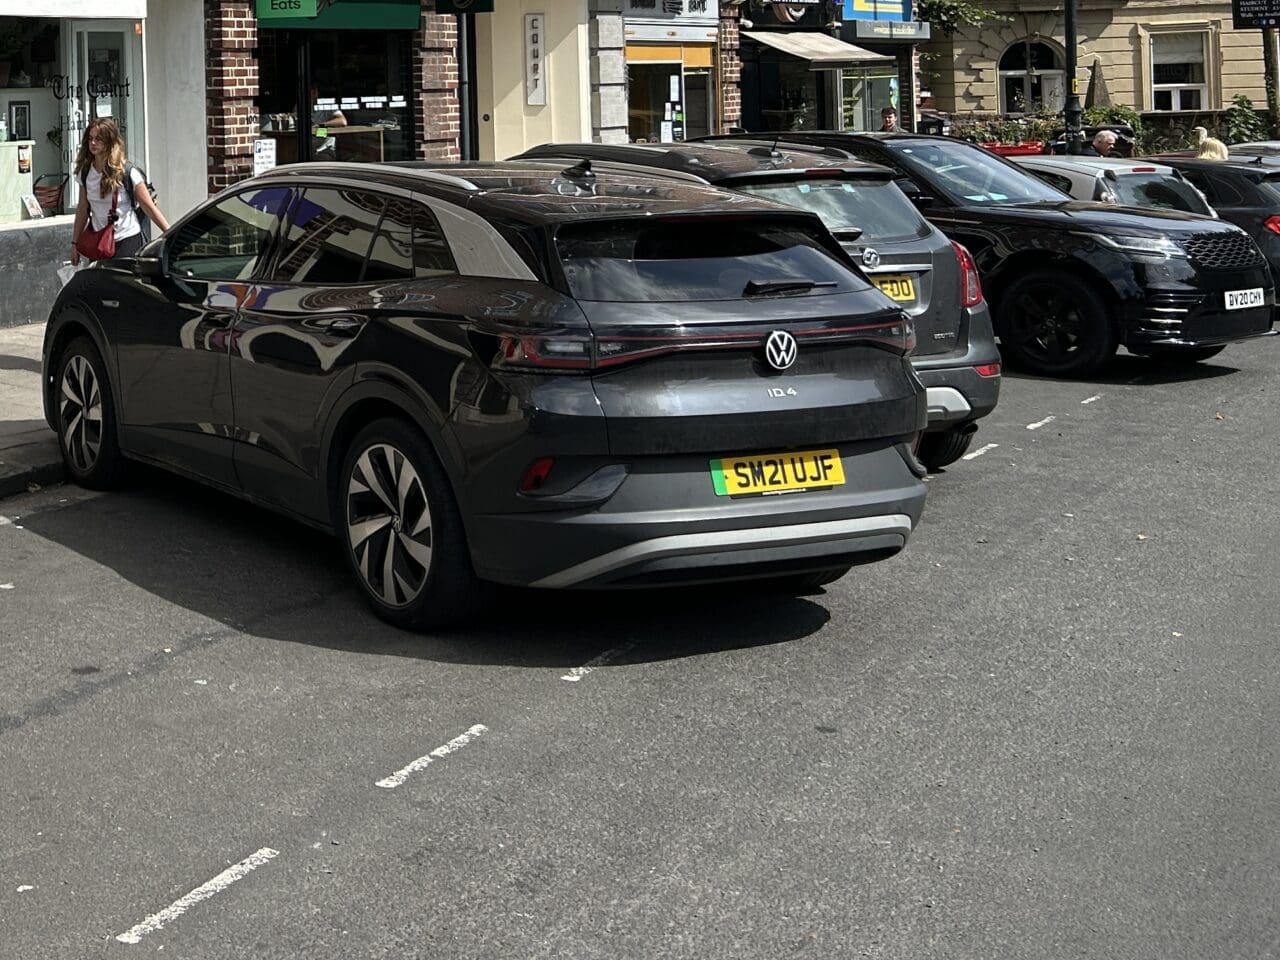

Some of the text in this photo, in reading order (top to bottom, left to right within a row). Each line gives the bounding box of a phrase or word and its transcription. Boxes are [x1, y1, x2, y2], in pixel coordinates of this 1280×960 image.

[531, 18, 540, 89] COURT
[52, 74, 131, 100] The Court
[734, 454, 833, 488] SM21 UJF
